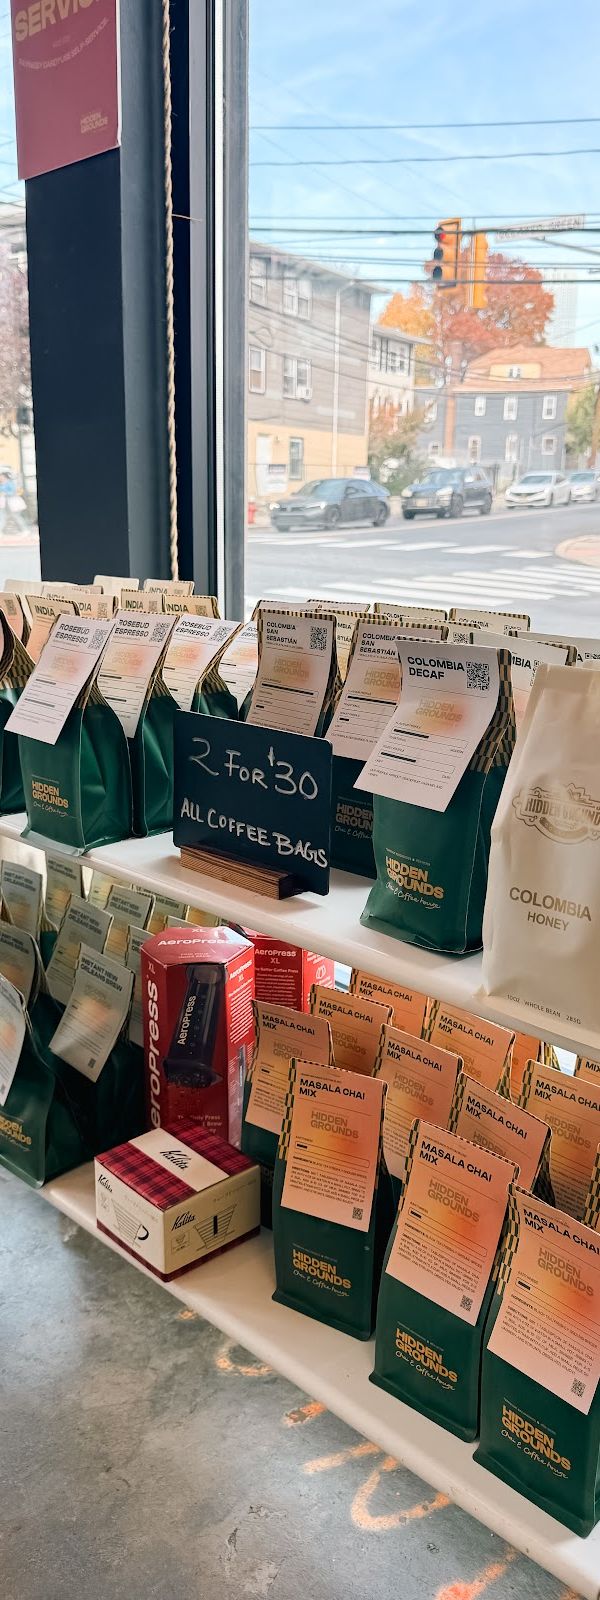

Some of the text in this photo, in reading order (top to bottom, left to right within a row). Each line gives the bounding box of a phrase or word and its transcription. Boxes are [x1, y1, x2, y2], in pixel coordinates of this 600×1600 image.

[34, 605, 56, 617] INDIA
[78, 602, 92, 612] DIA
[125, 600, 144, 610] INDIA
[166, 603, 190, 613] INDIA
[59, 624, 90, 634] ROSEBUD
[114, 627, 149, 637] ESPRESSO
[119, 620, 150, 629] ROSEBUD
[175, 628, 210, 637] ESPRESSO
[181, 620, 212, 631] ROSEBUD
[266, 621, 297, 630] COLOMBIA
[55, 632, 88, 644] ESPRESSO
[266, 635, 298, 645] SEBASTIÁN
[362, 632, 396, 641] COLOMBIA
[360, 646, 396, 656] SEBASTIÁN
[407, 656, 465, 672] COLOMBIA
[408, 667, 445, 680] DECAF
[364, 677, 401, 690] GROUND
[415, 707, 464, 723] GROUNDS
[189, 737, 220, 777] 2
[31, 780, 60, 796] HIDDEN
[32, 790, 69, 809] GROUNDS
[335, 813, 373, 832] GROUN
[180, 797, 328, 869] ALL COFFEE BAGS
[385, 856, 429, 882] HIDDEN
[386, 867, 445, 899] GROUNDS
[509, 886, 592, 922] COLOMBIA
[527, 911, 570, 932] HONEY
[254, 948, 297, 957] AeroPress
[80, 963, 123, 992] ORLEANS BREW
[81, 957, 119, 982] INSTANT NEW
[359, 987, 374, 998] MIX
[360, 980, 413, 1002] MASALA CHAI
[318, 1007, 333, 1018] MIX
[319, 1000, 373, 1023] MASALA CHAI
[524, 1001, 544, 1012] WHOLE
[545, 1007, 561, 1018] BEAN
[176, 995, 197, 1046] AeroPress
[262, 1014, 315, 1036] MASALA CHAI
[262, 1020, 277, 1030] MIX
[438, 1022, 453, 1035] MIX
[333, 1029, 358, 1044] IDDEN
[440, 1015, 495, 1046] MASALA CHAI
[147, 979, 161, 1128] eroPress
[386, 1050, 401, 1061] MIX
[387, 1041, 422, 1063] MASALA
[422, 1056, 443, 1072] CHAI
[585, 1061, 600, 1073] MIX
[299, 1088, 317, 1098] MIX
[300, 1078, 366, 1100] MASALA CHAI
[534, 1088, 552, 1102] MIX
[535, 1079, 600, 1112] MASALA CHAI
[311, 1110, 349, 1127] HIDDEN
[465, 1103, 482, 1120] MIX
[467, 1095, 528, 1140] MASALA CHAI
[310, 1121, 359, 1139] GROUNDS
[159, 1149, 192, 1170] Kalita
[419, 1150, 439, 1166] MIX
[421, 1141, 492, 1183] MASALA CHAI
[97, 1174, 114, 1193] Kalita
[429, 1179, 470, 1205] HIDDEN
[427, 1188, 480, 1223] GROUNDS
[171, 1210, 197, 1232] Kalita
[524, 1217, 544, 1234] MIX
[523, 1209, 600, 1254] MASALA CHAI
[292, 1249, 337, 1275] HIDDEN
[538, 1247, 582, 1280] HIDDEN
[292, 1258, 352, 1289] GROUNDS
[537, 1257, 595, 1297] GROUNDS
[312, 1278, 330, 1291] Coffee
[395, 1328, 444, 1363] HIDDEN
[395, 1338, 459, 1383] GROUNDS
[415, 1363, 436, 1381] Coffee
[502, 1405, 555, 1450] HIDDEN
[501, 1416, 571, 1471] GROUNDS
[523, 1447, 546, 1466] Coffee
